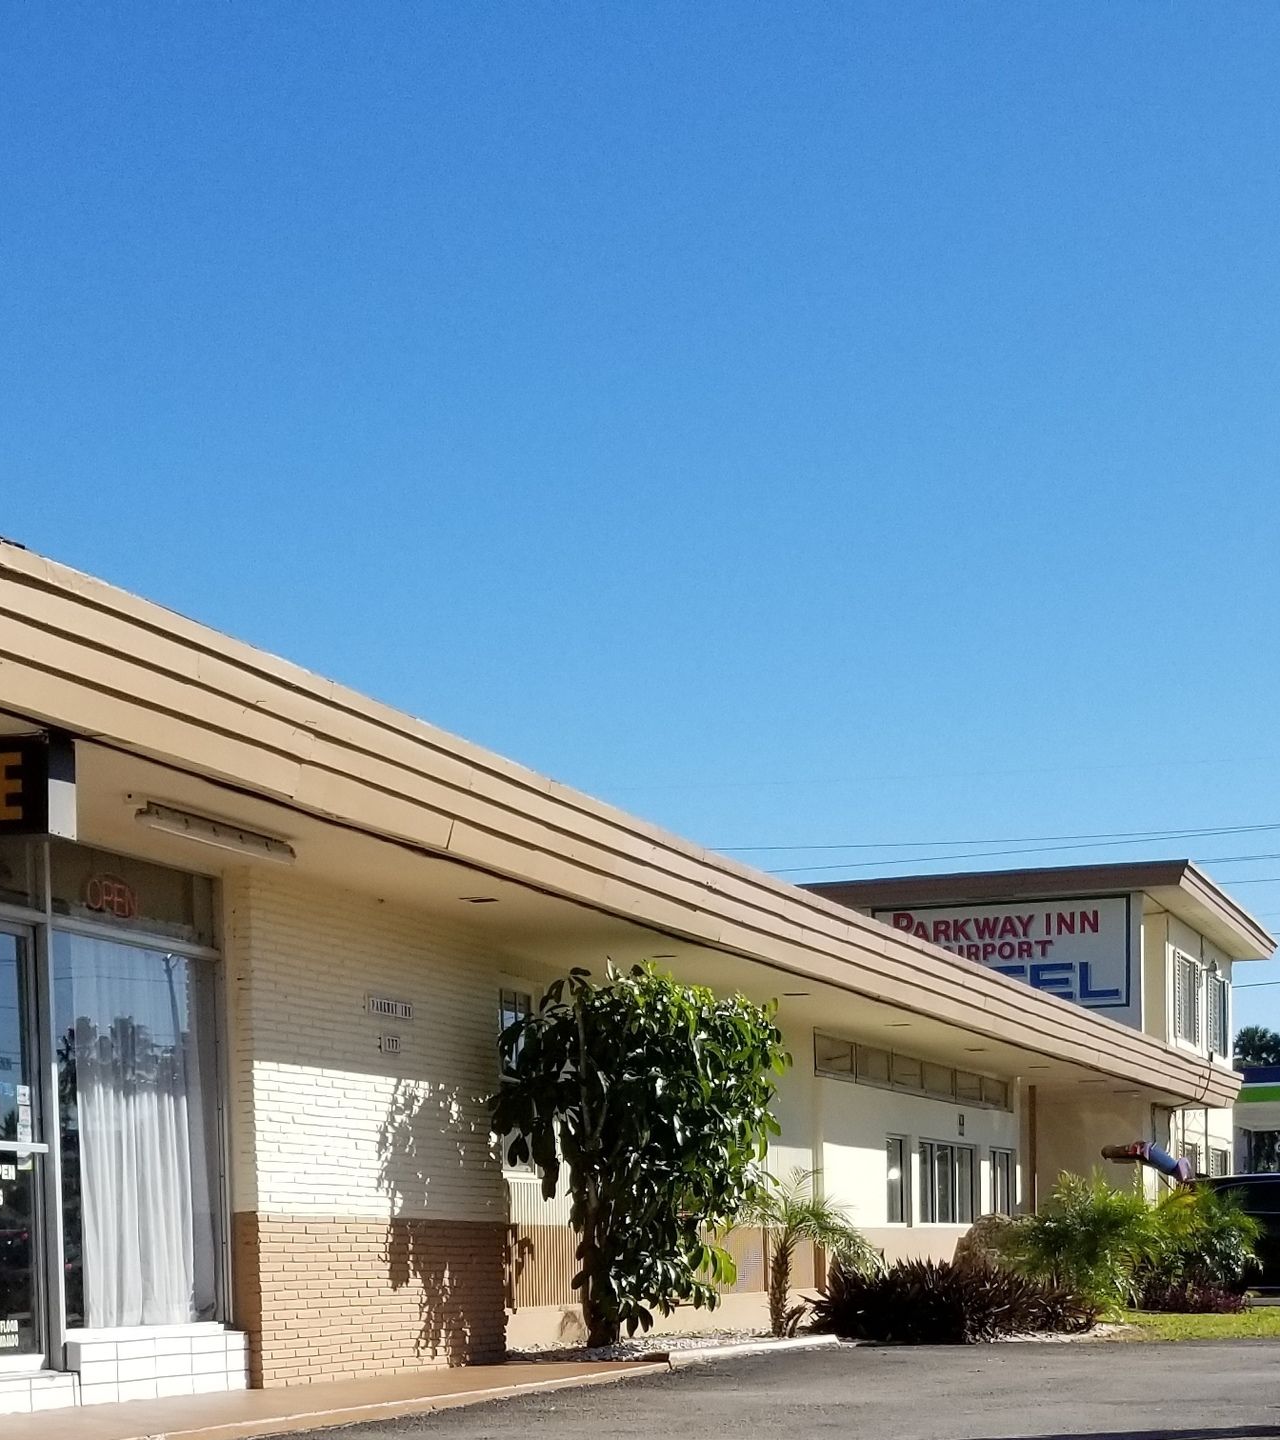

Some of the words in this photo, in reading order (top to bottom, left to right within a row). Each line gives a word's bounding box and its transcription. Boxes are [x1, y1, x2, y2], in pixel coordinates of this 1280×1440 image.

[87, 879, 138, 917] OPEN
[893, 912, 1035, 942] PARKWAY
[1045, 910, 1100, 936] INN
